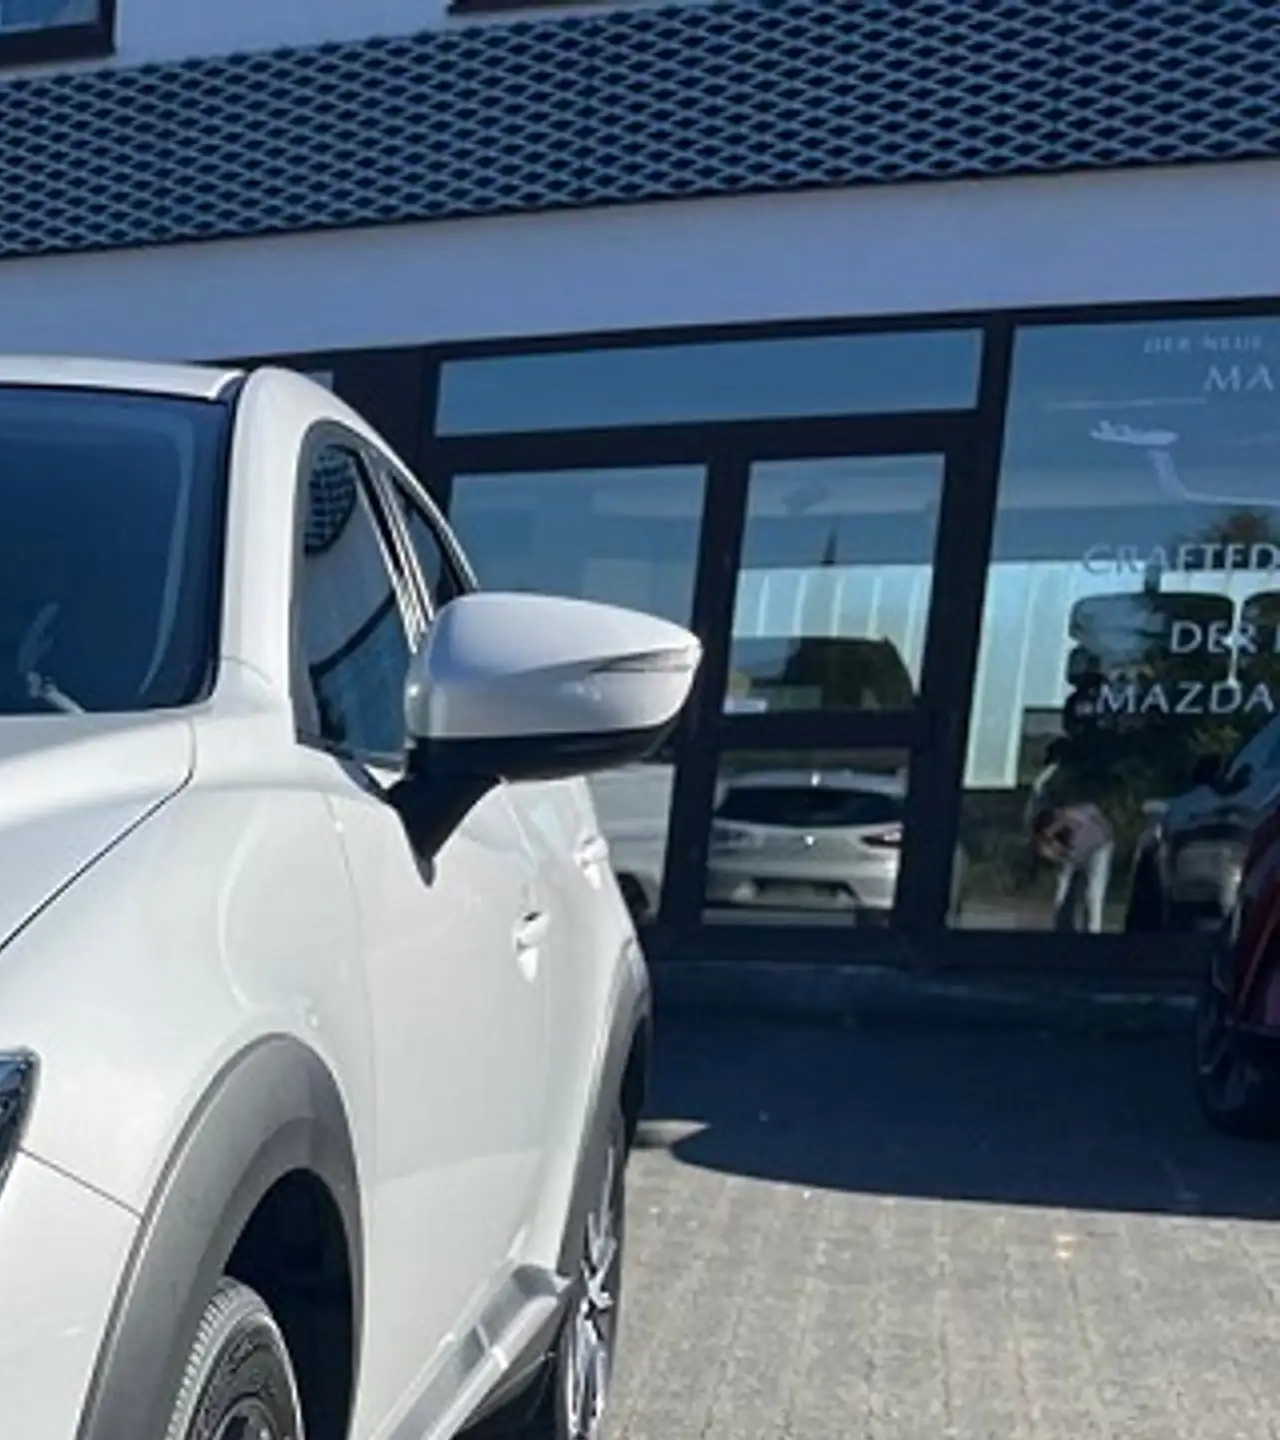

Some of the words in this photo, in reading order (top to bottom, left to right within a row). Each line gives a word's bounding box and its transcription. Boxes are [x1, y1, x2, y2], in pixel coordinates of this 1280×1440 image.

[1082, 542, 1280, 575] CRAFTED
[1170, 620, 1258, 654] DER
[1096, 681, 1276, 714] MAZDA
